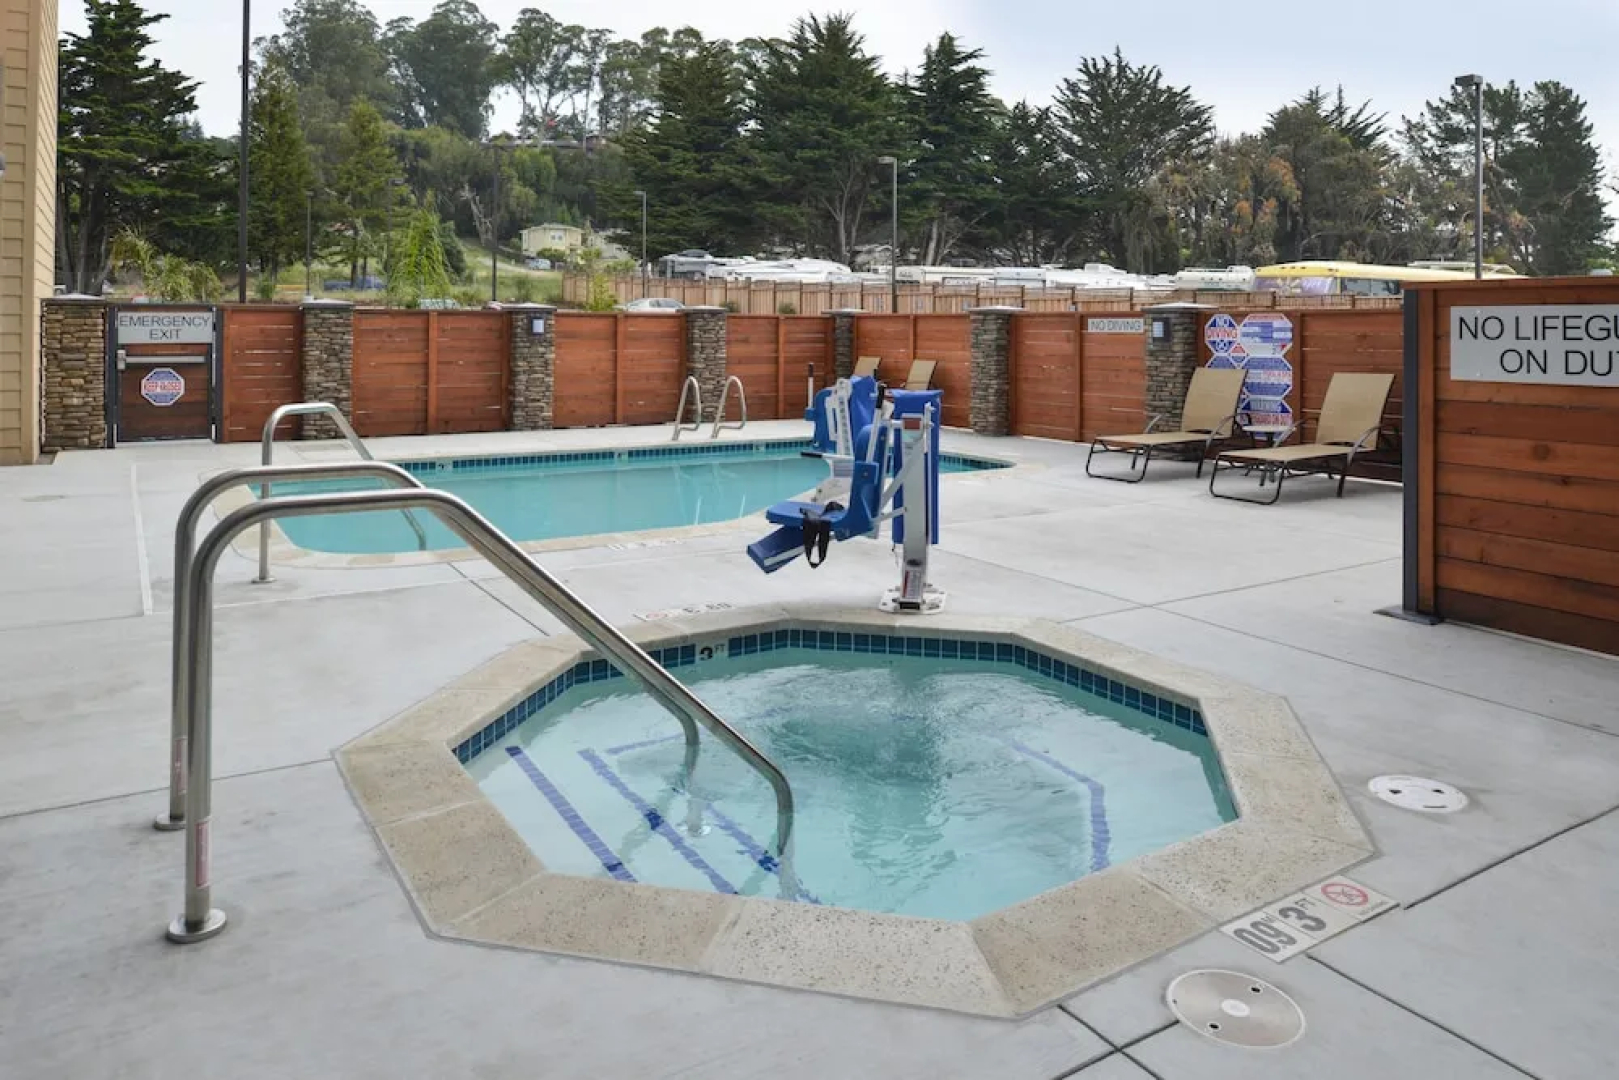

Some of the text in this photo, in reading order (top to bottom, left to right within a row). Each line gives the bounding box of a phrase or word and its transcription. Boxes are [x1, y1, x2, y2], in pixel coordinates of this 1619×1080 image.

[119, 316, 210, 327] EMERGENCY
[1090, 319, 1141, 331] NO DIVING
[1459, 315, 1504, 341] NO
[150, 329, 182, 339] EXIT
[1500, 349, 1619, 376] ON DU
[699, 646, 713, 661] 3
[1278, 906, 1327, 932] 3
